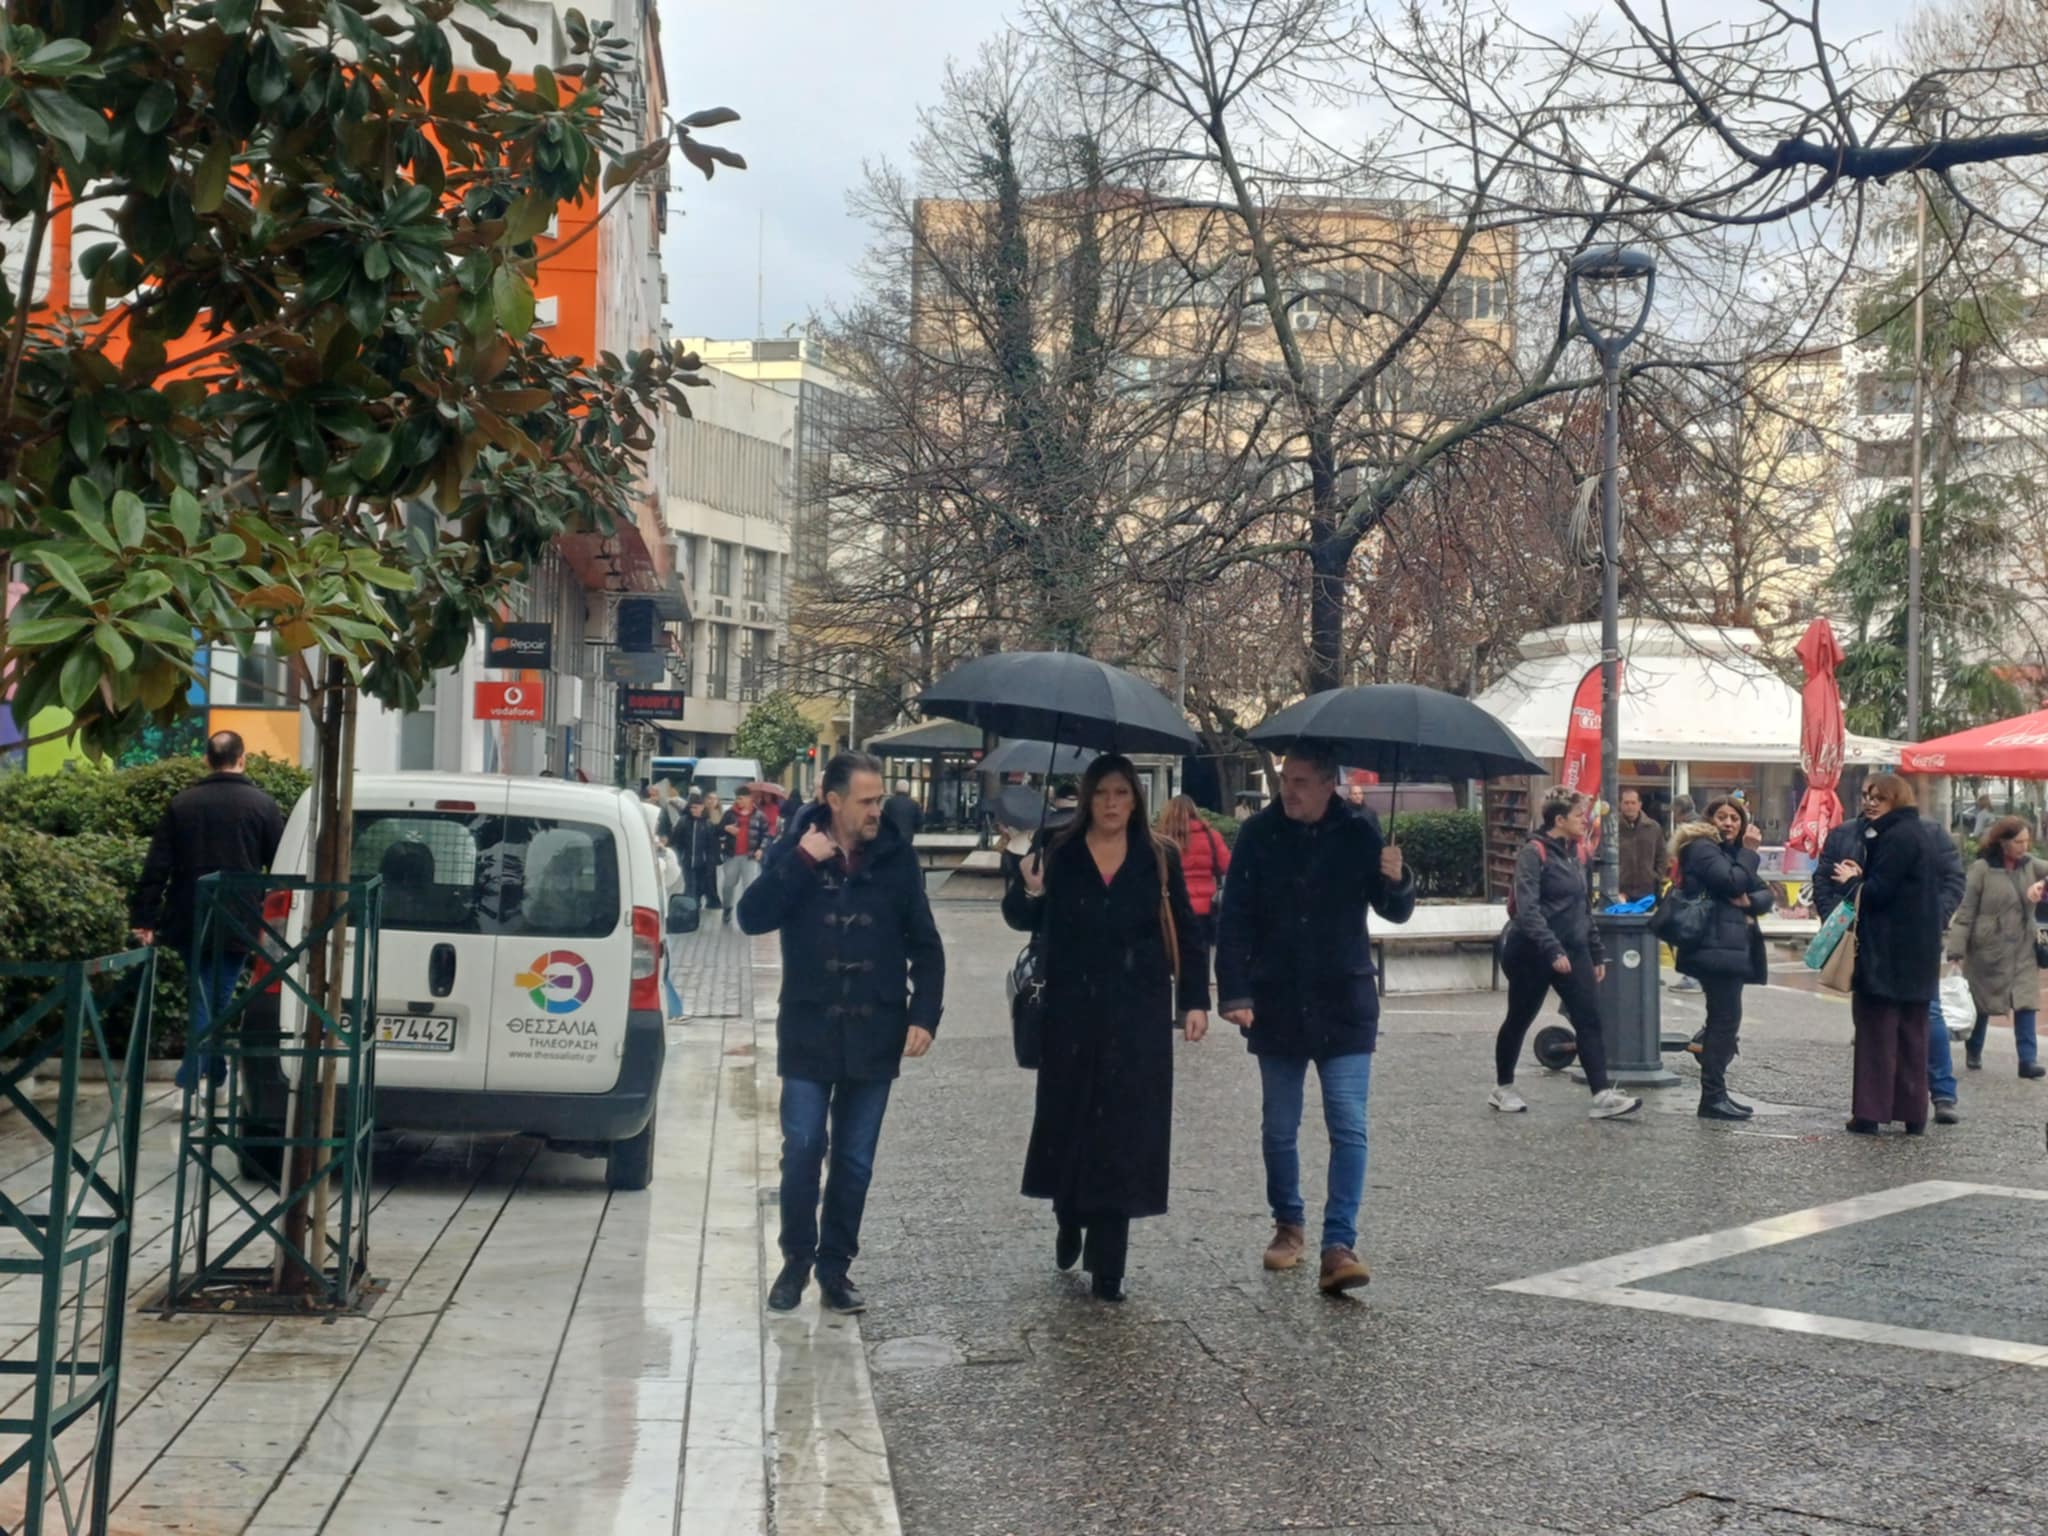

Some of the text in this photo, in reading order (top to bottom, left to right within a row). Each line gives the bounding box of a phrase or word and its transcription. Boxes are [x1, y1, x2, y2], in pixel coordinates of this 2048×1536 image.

[490, 706, 535, 716] vodafone
[393, 1018, 449, 1042] 7442
[505, 1017, 598, 1036] ΘΕΣΣΑΛΙΑ
[529, 1038, 598, 1050] ΤΗΛΕΟΡΑΣΗ
